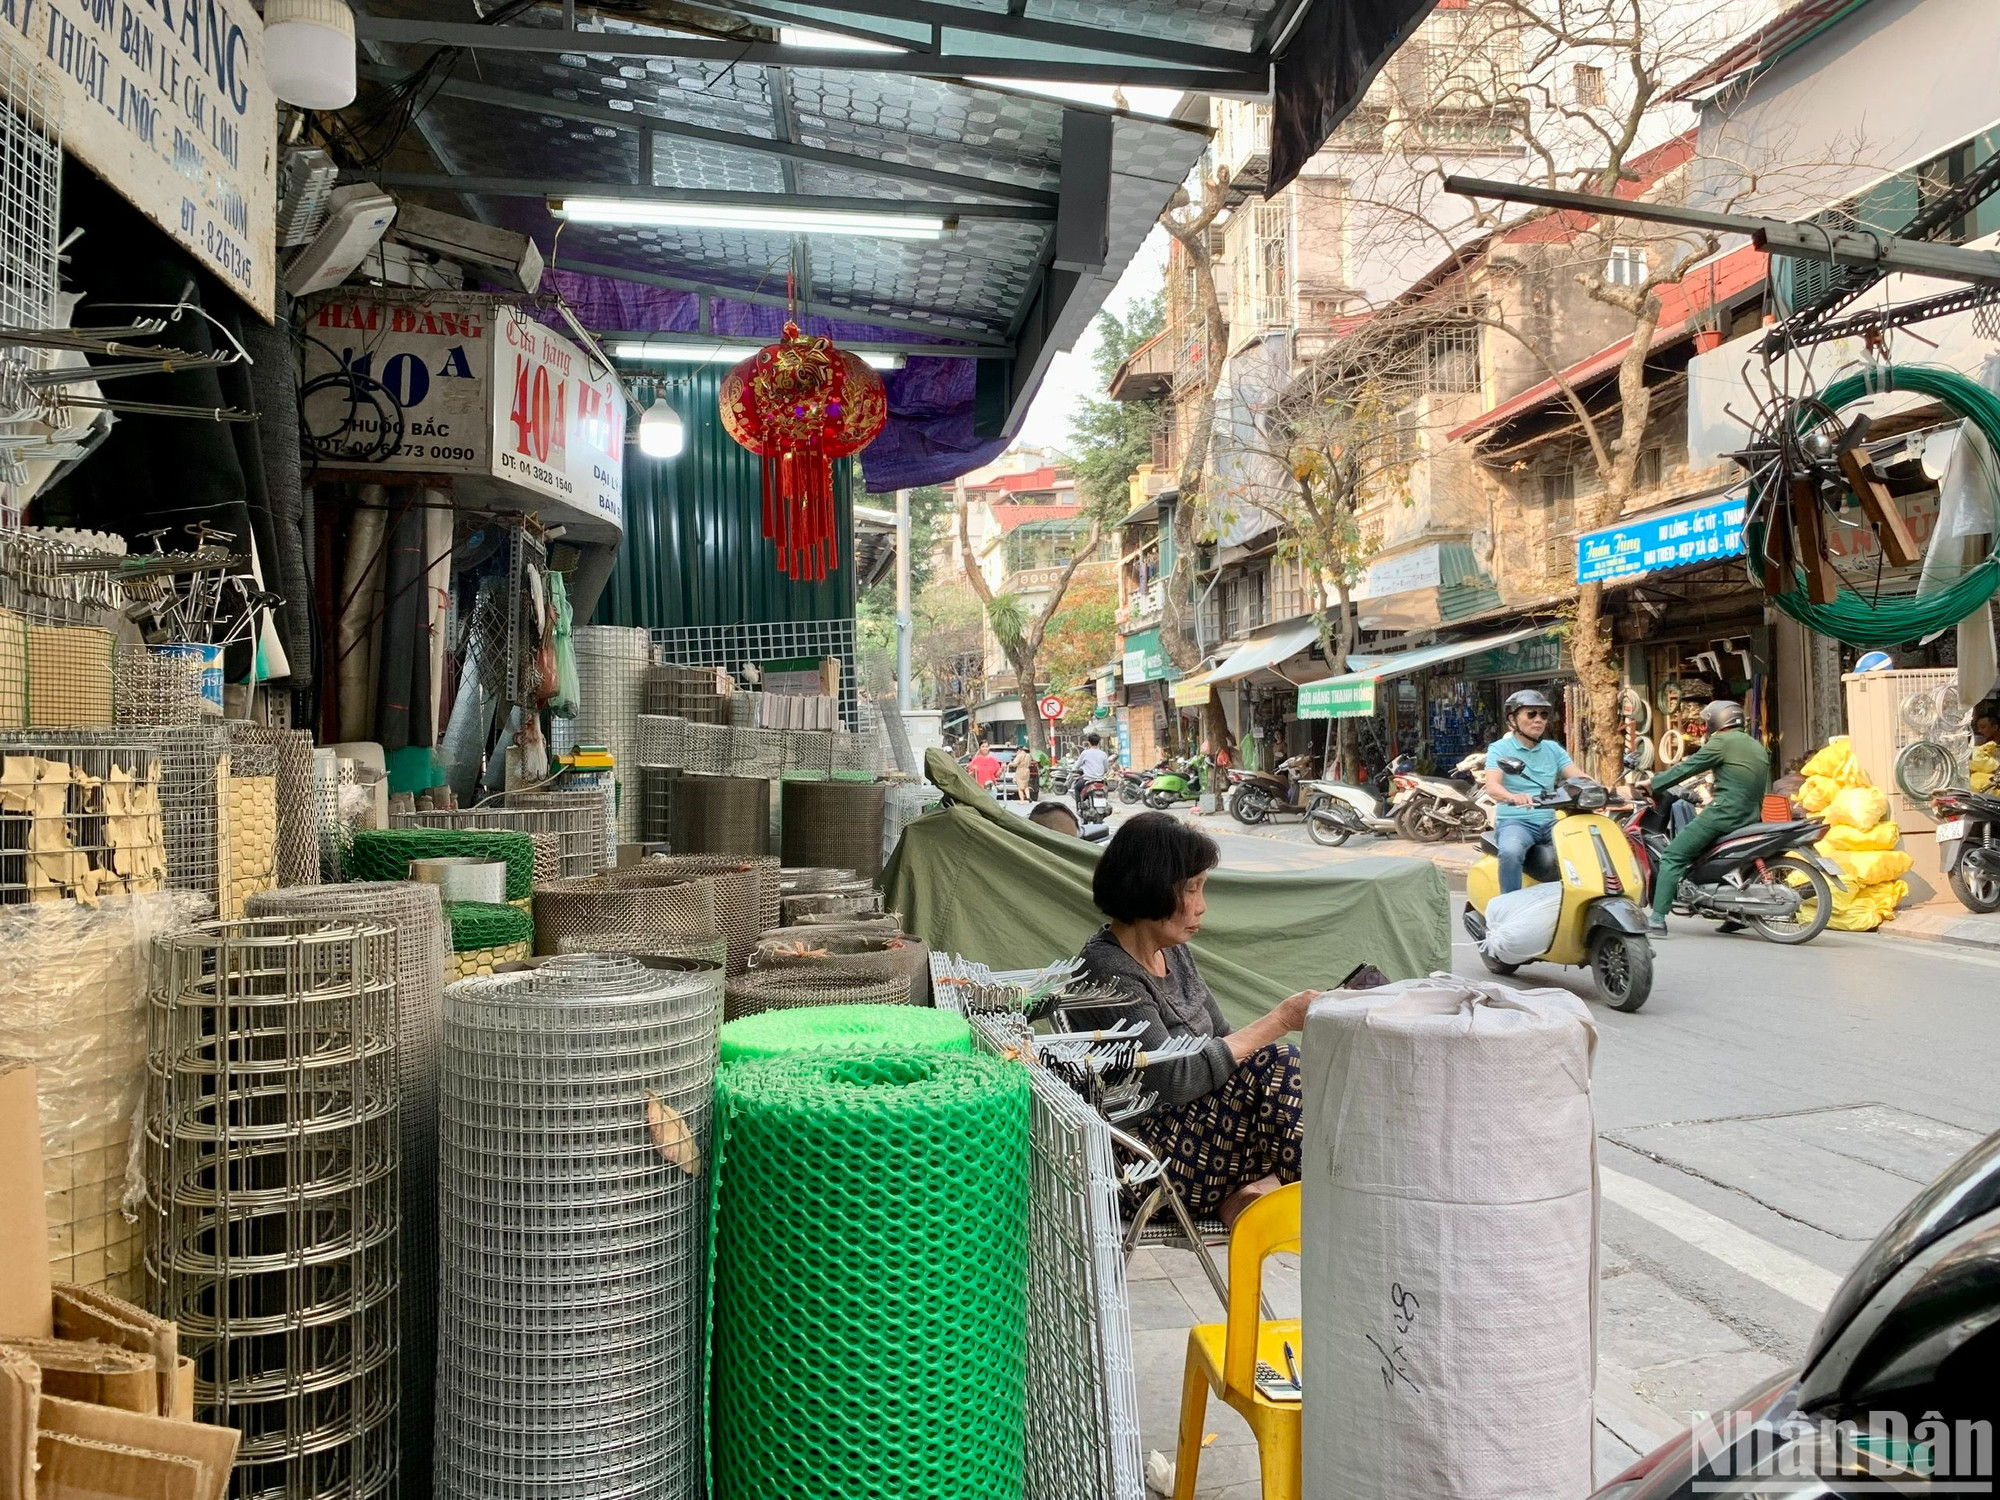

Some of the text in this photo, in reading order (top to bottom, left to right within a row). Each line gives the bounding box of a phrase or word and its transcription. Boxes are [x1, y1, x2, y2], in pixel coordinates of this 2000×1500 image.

[411, 416, 449, 438] BẮC
[430, 447, 475, 461] 0090
[519, 460, 532, 476] 04
[533, 465, 553, 485] 3828
[555, 476, 573, 494] 1540
